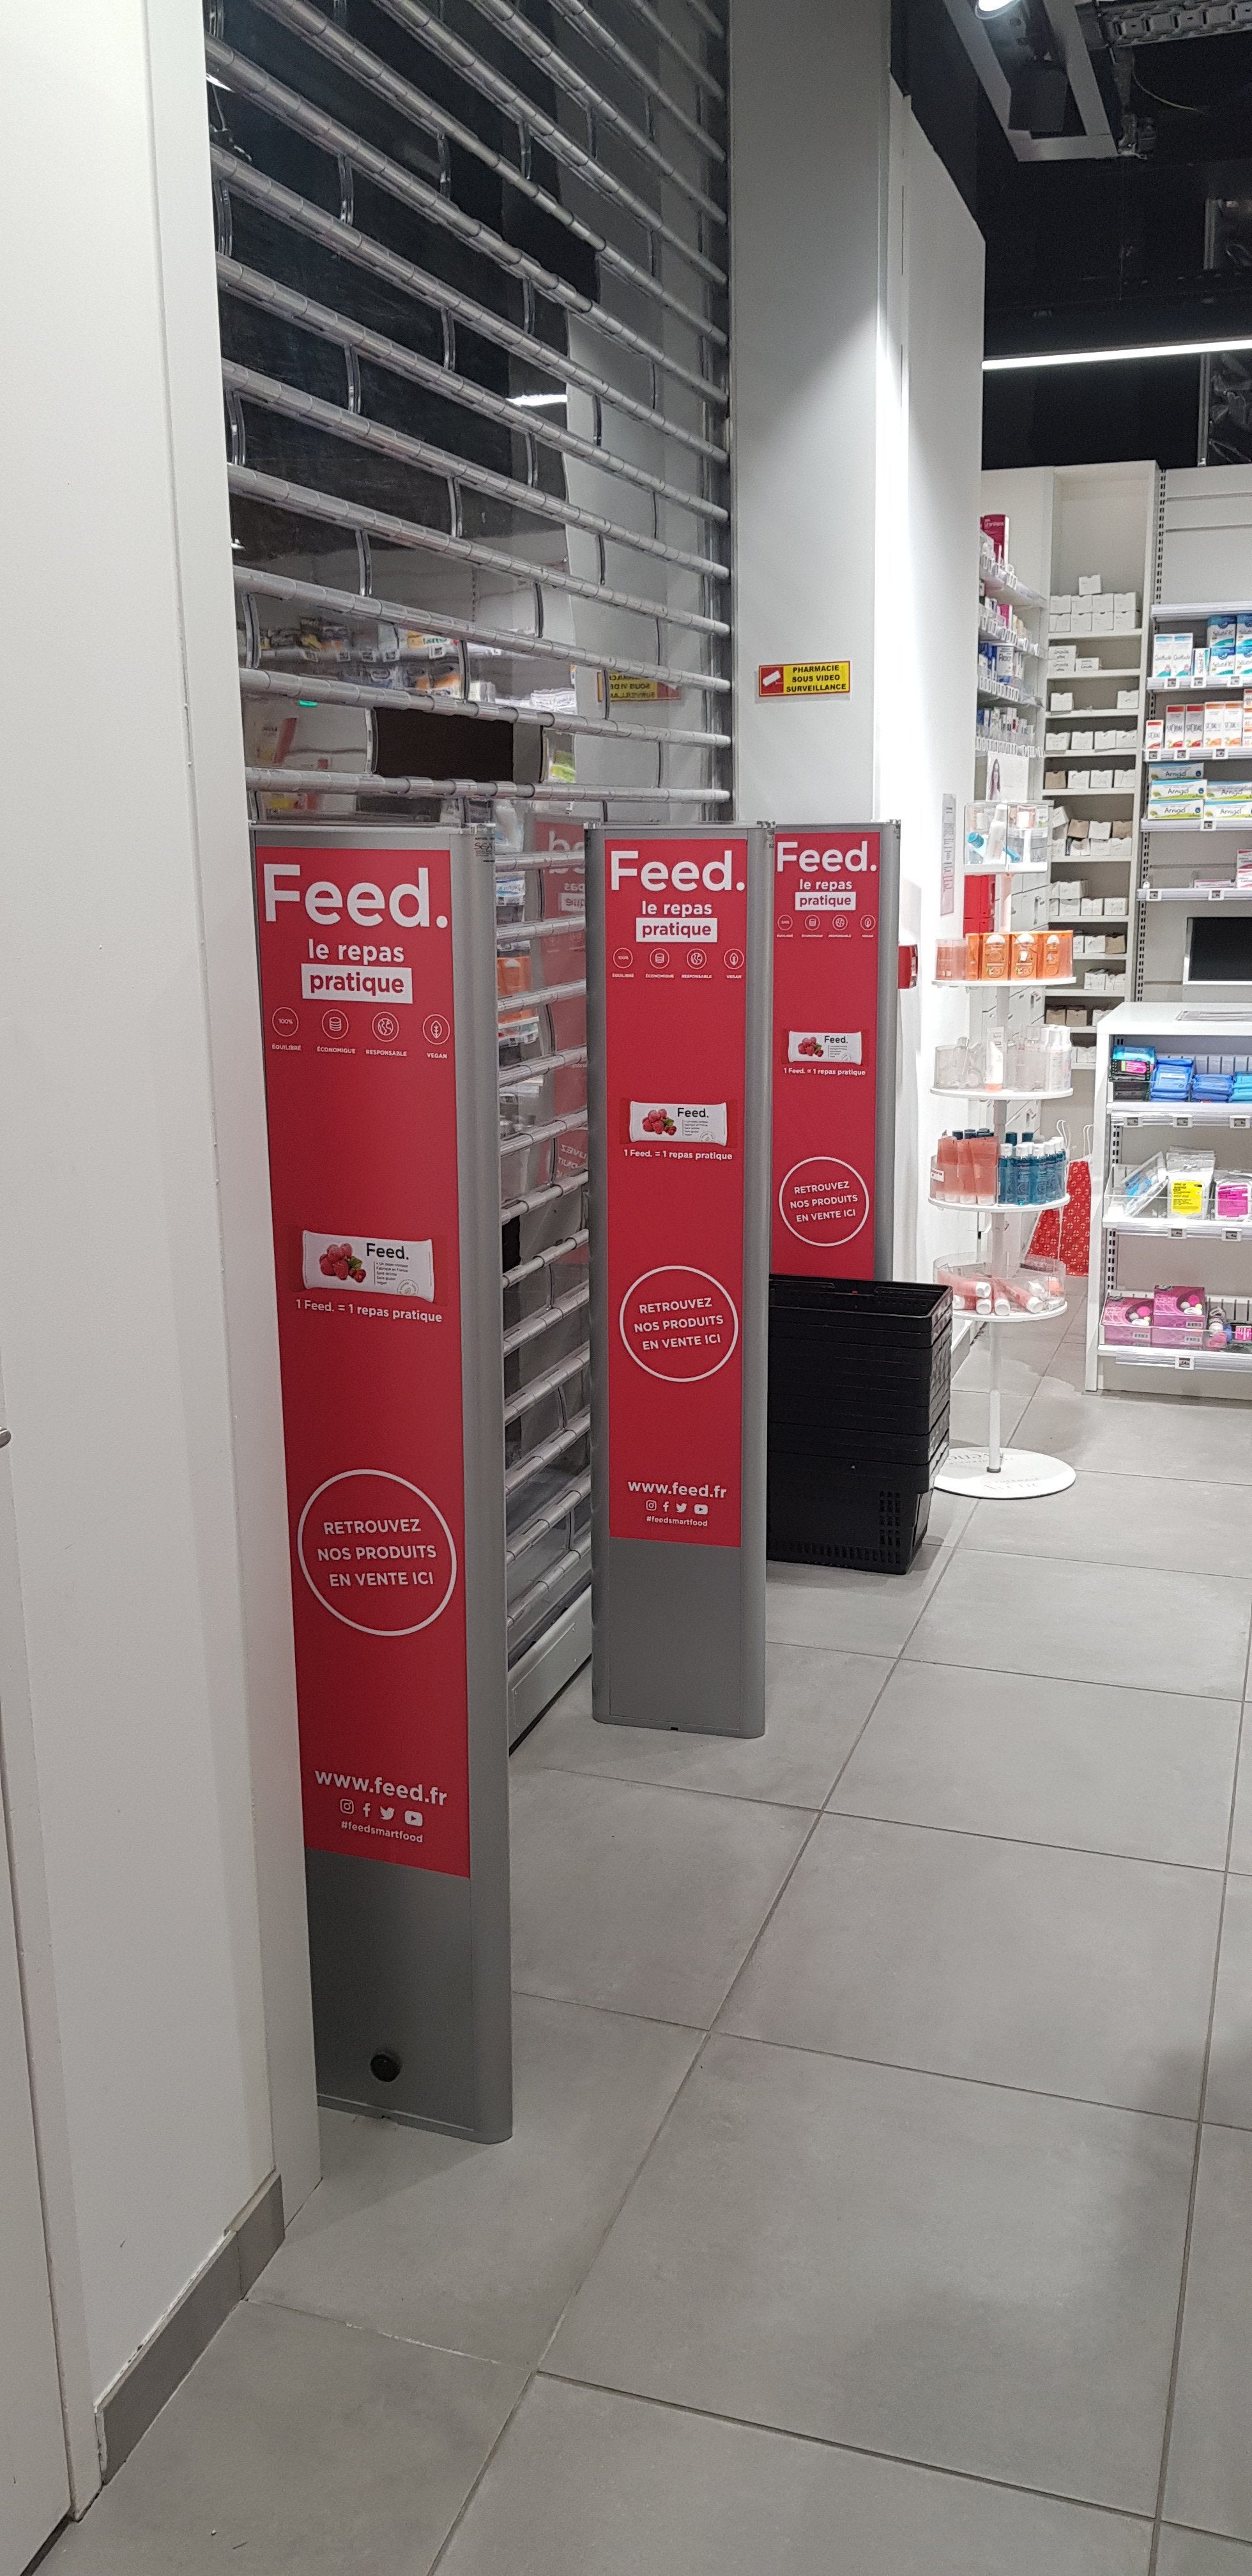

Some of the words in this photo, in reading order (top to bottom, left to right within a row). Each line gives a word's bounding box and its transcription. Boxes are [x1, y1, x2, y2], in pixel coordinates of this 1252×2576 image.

[786, 684, 846, 693] SURVEILLANCE
[777, 841, 877, 872] Feed.
[611, 850, 745, 891] Feed.
[800, 878, 811, 890] le
[816, 880, 852, 891] repas
[263, 863, 448, 928] Feed.
[800, 895, 851, 907] pratique
[642, 900, 657, 915] le
[663, 903, 712, 917] repas
[642, 923, 712, 938] pratique
[309, 938, 329, 959] le
[338, 944, 404, 965] repas
[310, 972, 404, 996] pratique
[824, 1036, 848, 1044] Feed.
[317, 1046, 356, 1054] ÉCONOMIQUE
[677, 1107, 709, 1118] Feed.
[794, 1181, 850, 1194] RETROUVEZ
[790, 1200, 809, 1209] NOS
[812, 1195, 858, 1207] PRODUITS
[811, 1210, 841, 1221] VENTE
[844, 1209, 856, 1217] ICI
[366, 1243, 409, 1261] Feed.
[296, 1299, 301, 1309] 1
[305, 1300, 334, 1312] Feed.
[348, 1304, 353, 1314] 1
[357, 1306, 389, 1317] repas
[392, 1309, 443, 1322] pratique
[639, 1297, 712, 1314] RETROUVEZ
[634, 1322, 660, 1333] NOS
[662, 1315, 724, 1330] PRODUITS
[643, 1340, 659, 1350] EN
[662, 1336, 701, 1348] VENTE
[705, 1334, 721, 1344] ICI
[627, 1482, 727, 1498] www.feed.fr
[323, 1519, 422, 1535] RETROUVEZ
[646, 1515, 708, 1526] #feedsmartfood
[317, 1548, 351, 1561] NOS
[355, 1545, 437, 1560] PRODUITS
[329, 1574, 351, 1587] EN
[355, 1572, 409, 1586] VENTE
[413, 1571, 434, 1584] ICI
[314, 1770, 447, 1806] www.feed.fr
[341, 1821, 423, 1843] #feedsmartfood
